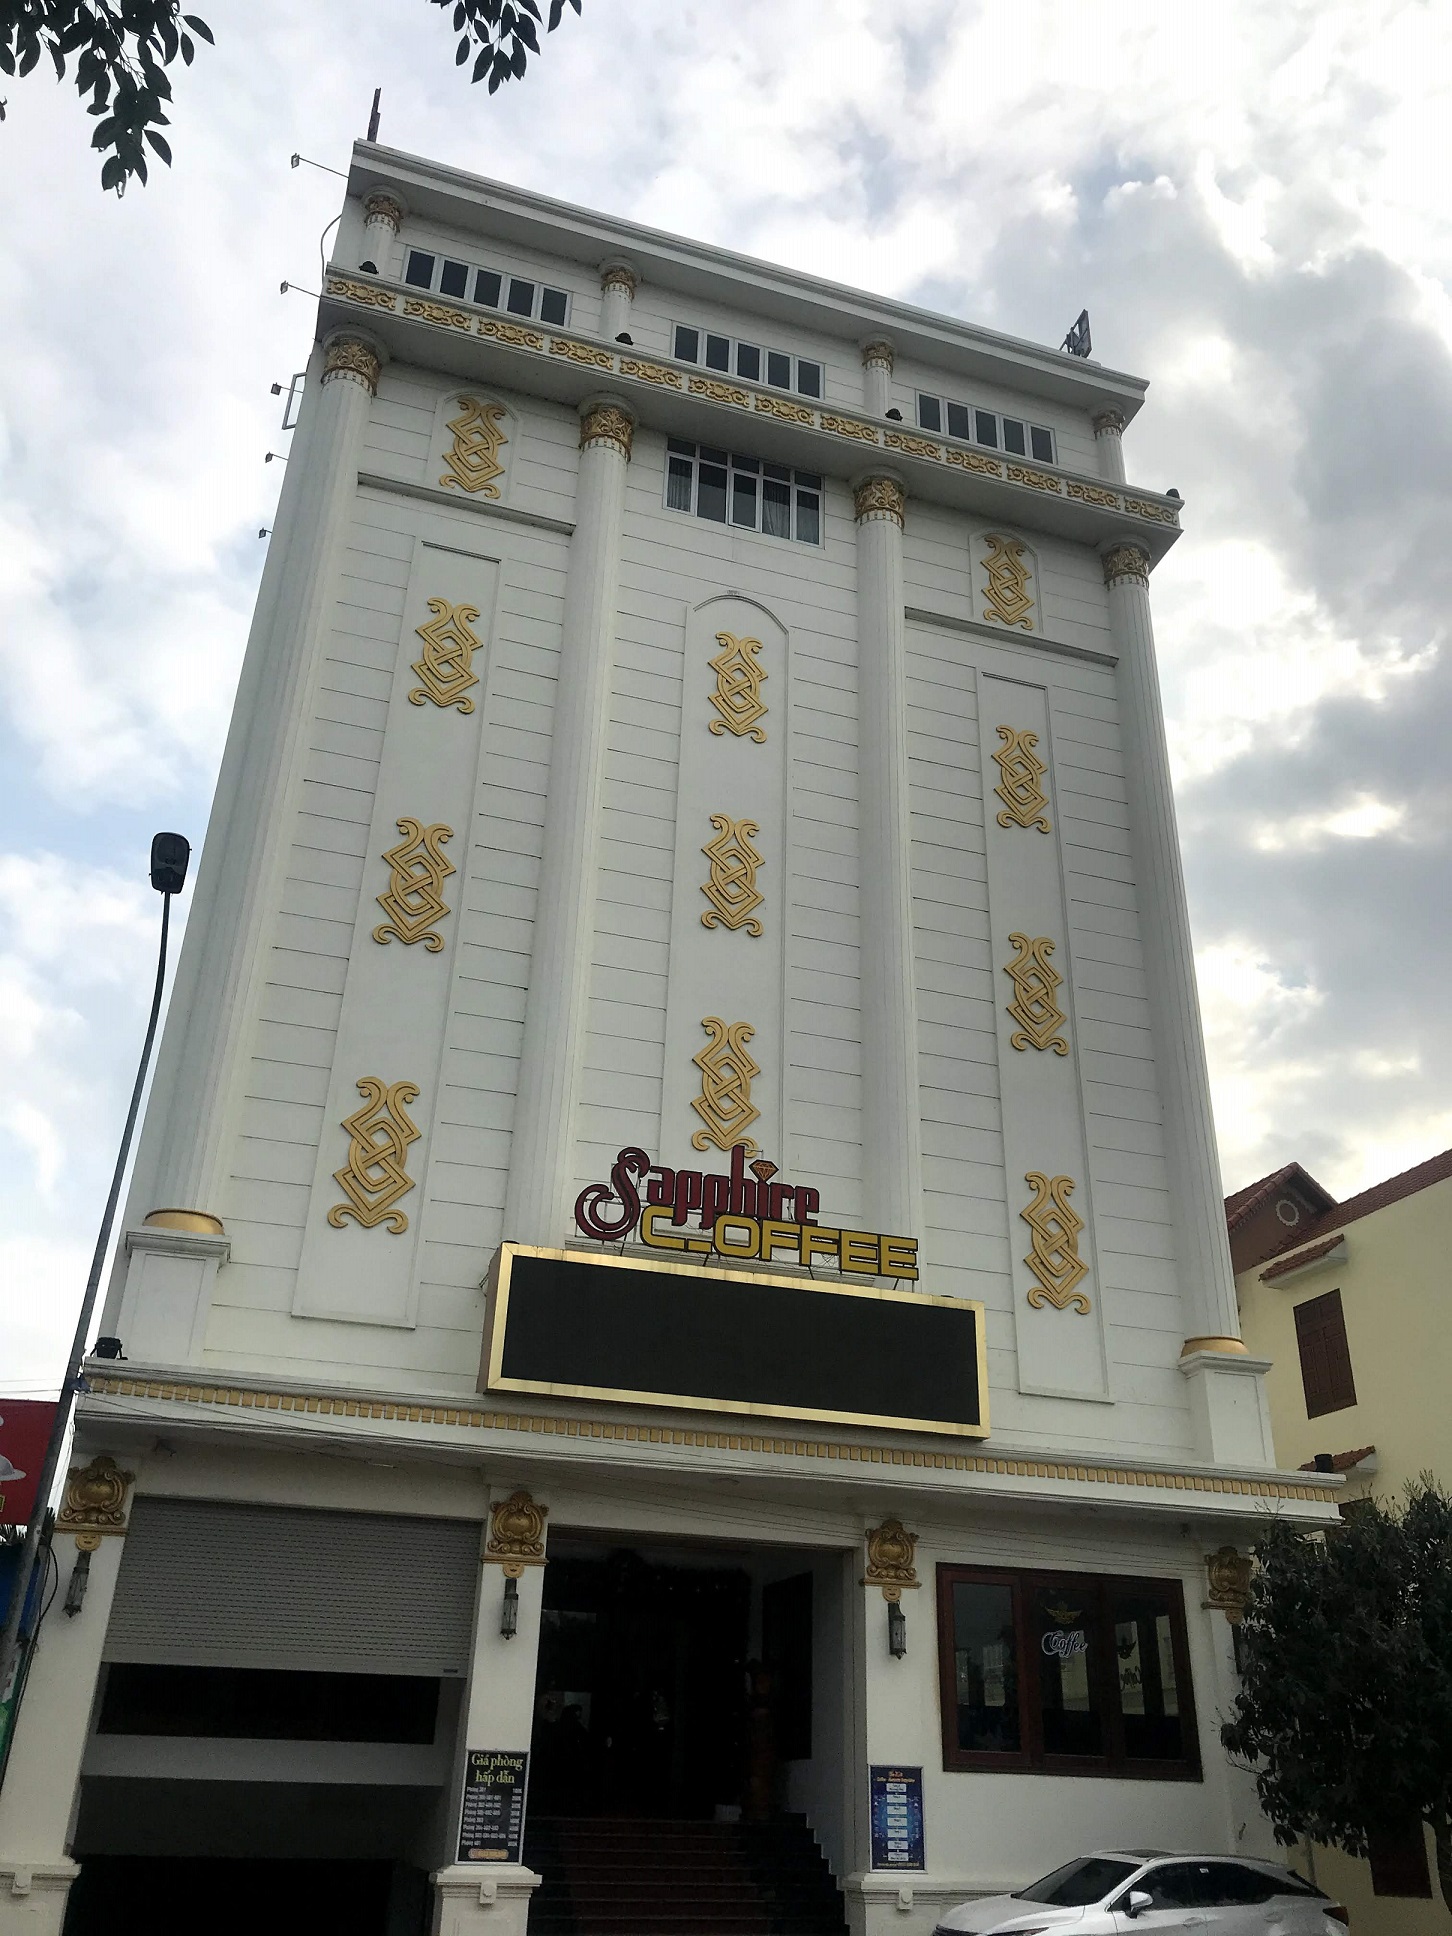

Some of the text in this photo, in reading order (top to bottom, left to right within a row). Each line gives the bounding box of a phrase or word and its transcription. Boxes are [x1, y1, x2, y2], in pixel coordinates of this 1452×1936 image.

[575, 1145, 820, 1241] Sapphire
[640, 1205, 920, 1280] COFFEE
[1041, 1630, 1088, 1658] Coffee
[472, 1753, 523, 1771] Giá phòng
[476, 1769, 495, 1786] hấp
